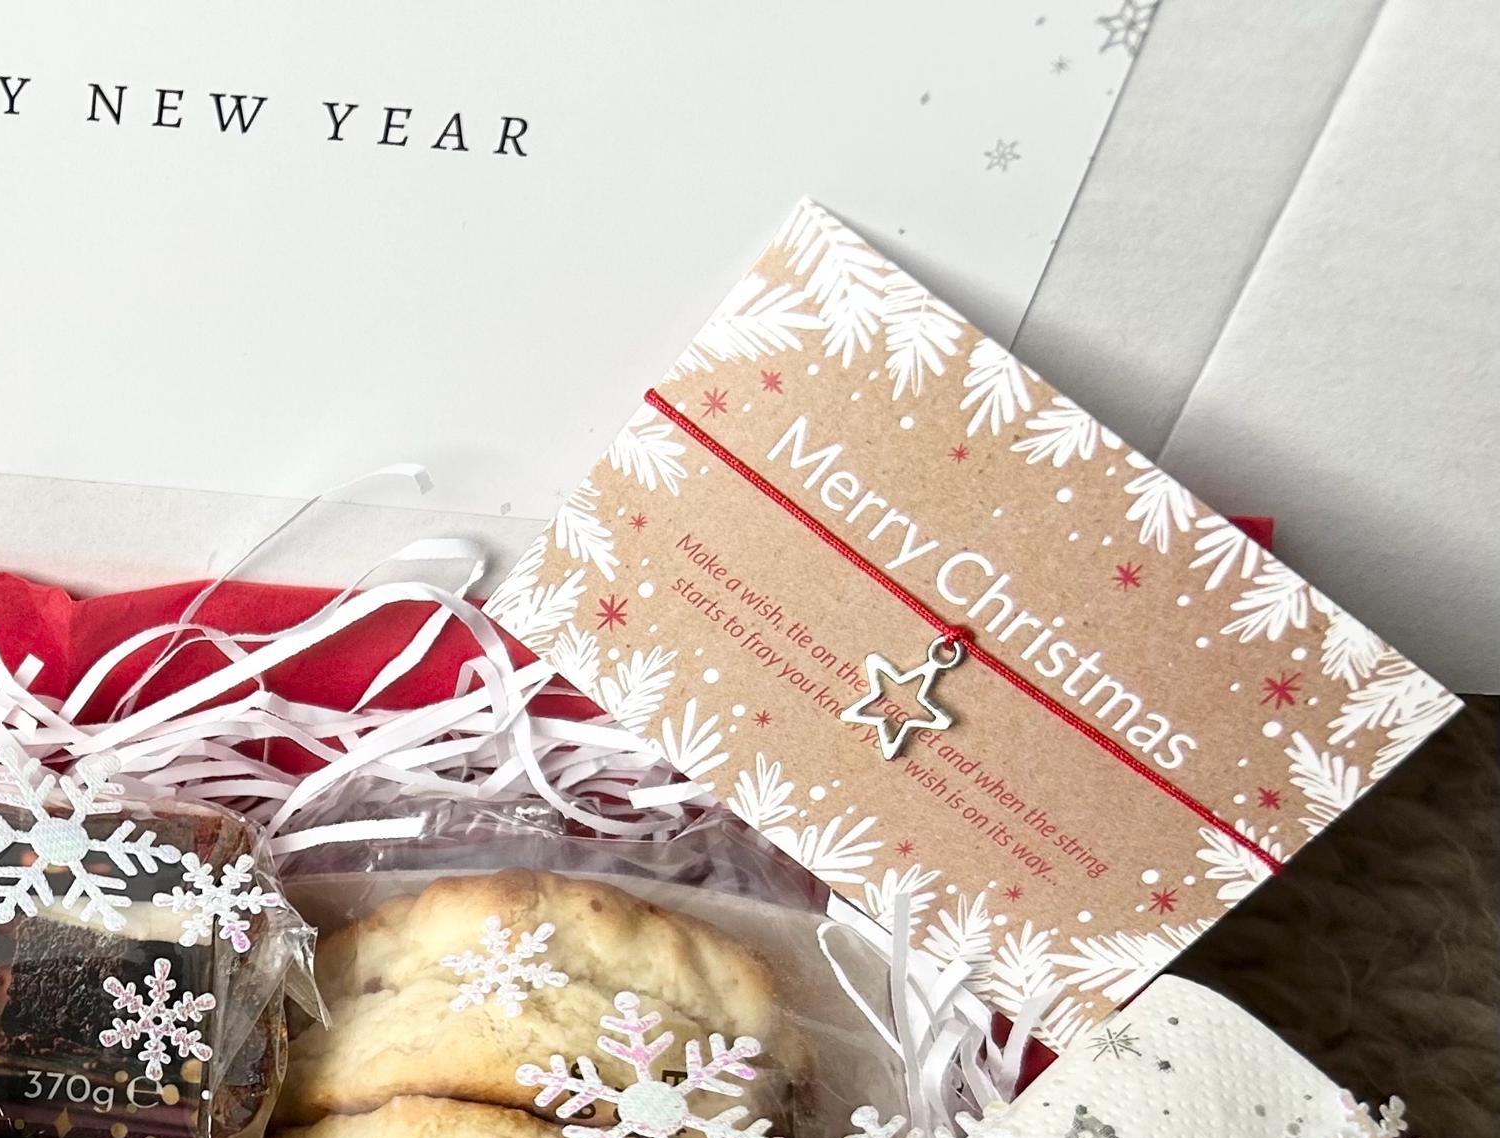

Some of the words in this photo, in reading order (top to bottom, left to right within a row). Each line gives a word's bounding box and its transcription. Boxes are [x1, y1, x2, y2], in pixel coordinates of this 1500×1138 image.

[86, 82, 268, 135] NEW
[321, 101, 532, 157] YEAR
[671, 577, 726, 622] starts
[722, 614, 745, 639] to
[740, 632, 784, 668] fray
[776, 663, 817, 695] you
[904, 759, 948, 798] wish
[944, 790, 966, 812] is
[962, 804, 990, 831] on
[985, 821, 1015, 849] its
[675, 533, 728, 582] Make
[724, 578, 742, 593] a
[740, 586, 784, 632] wish,
[786, 622, 813, 649] tie
[811, 645, 838, 669] on
[836, 662, 869, 693] the
[936, 743, 981, 776] and
[972, 769, 1027, 815] when
[1022, 804, 1057, 839] the
[1052, 835, 1110, 880] string
[766, 415, 939, 571] Merry
[936, 551, 1198, 770] Christmas
[23, 1070, 115, 1113] 370g
